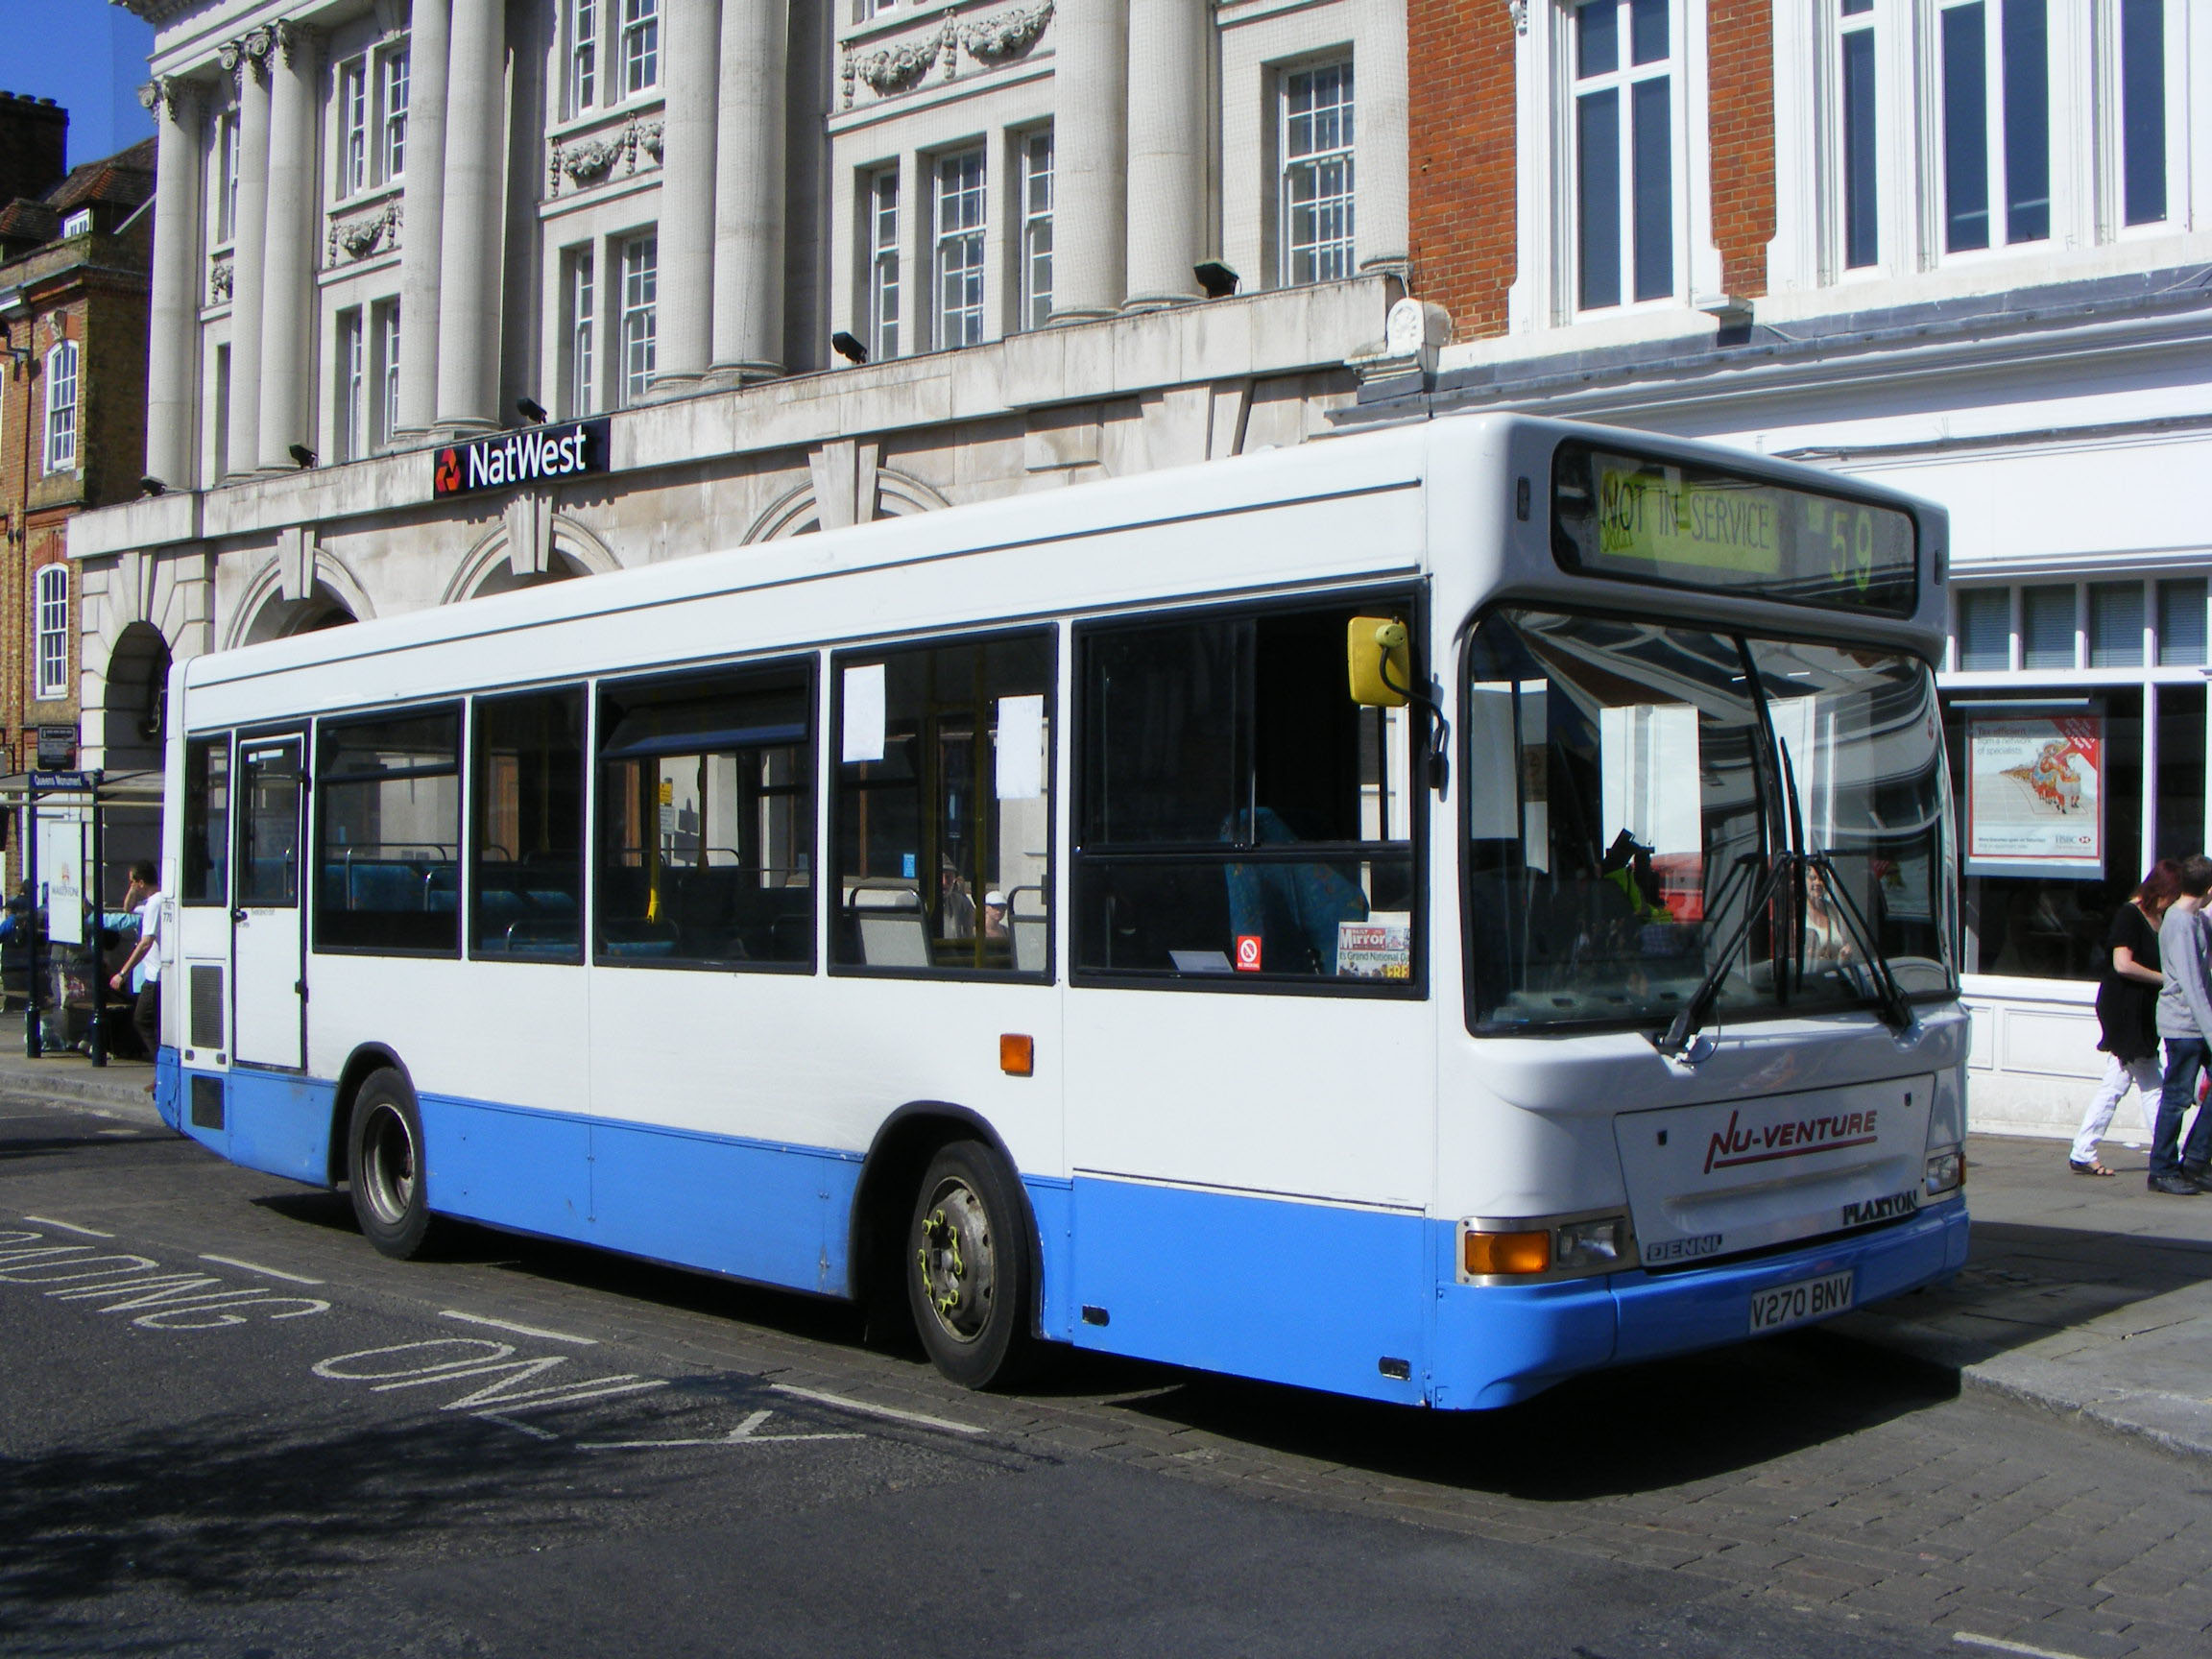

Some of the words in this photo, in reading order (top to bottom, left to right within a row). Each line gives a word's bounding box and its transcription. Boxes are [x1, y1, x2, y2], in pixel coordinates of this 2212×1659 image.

[469, 424, 587, 489] NatWest
[1601, 480, 1647, 533] NOT
[1658, 489, 1679, 536] IN
[1691, 492, 1769, 549] SERVICE
[1340, 928, 1385, 950] Mirror
[1347, 951, 1368, 960] Grand
[1841, 1190, 1917, 1225] PLAXTON
[1753, 1287, 1806, 1328] V270
[1811, 1277, 1851, 1313] BNV
[310, 1337, 867, 1449] ONLY
